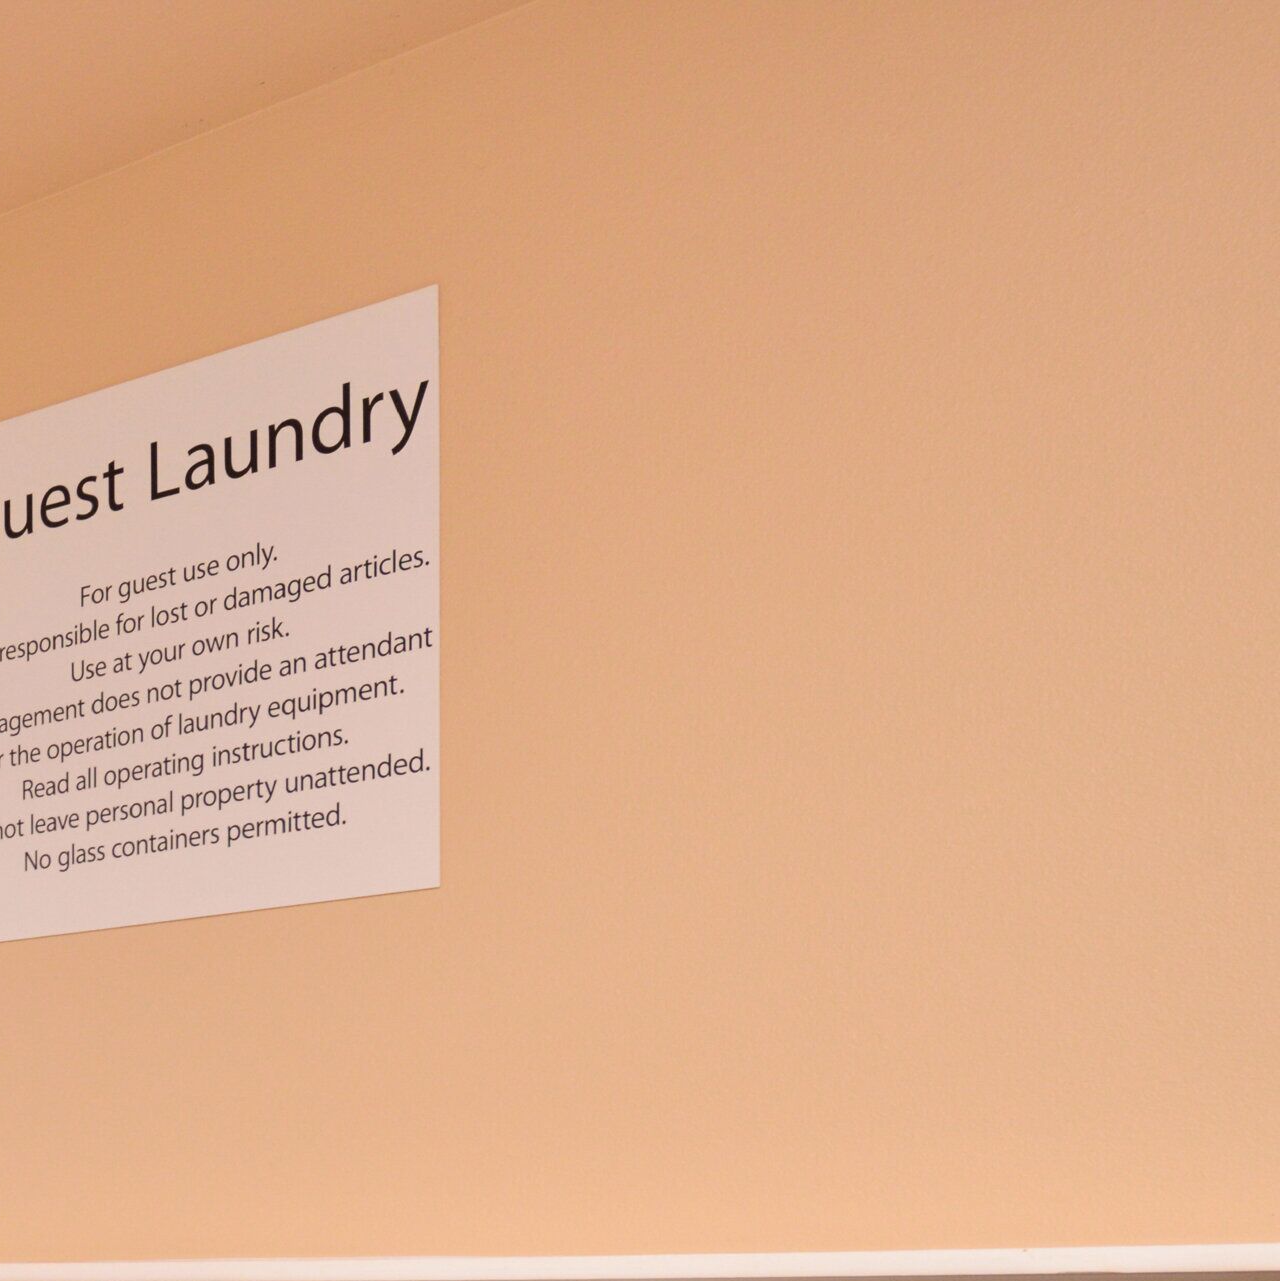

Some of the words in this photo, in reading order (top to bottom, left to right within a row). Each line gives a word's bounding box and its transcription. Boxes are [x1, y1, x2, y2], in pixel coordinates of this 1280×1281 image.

[149, 378, 431, 503] Laundry
[79, 583, 114, 609] For
[117, 566, 178, 605] guest
[182, 558, 221, 584] use
[225, 540, 279, 573] only.
[114, 611, 146, 637] for
[150, 601, 189, 629] lost
[193, 596, 219, 619] or
[222, 563, 333, 612] damaged
[338, 547, 431, 586] articles.
[70, 658, 108, 684] Use
[112, 651, 134, 675] at
[137, 642, 187, 676] your
[190, 630, 240, 658] own
[246, 615, 291, 646] risk.
[89, 689, 141, 716] does
[146, 678, 184, 705] not
[188, 657, 273, 703] provide
[277, 655, 308, 679] an
[313, 626, 434, 671] attendant
[7, 743, 42, 768] the
[45, 726, 145, 765] operation
[149, 713, 175, 742] of
[177, 700, 262, 737] laundry
[266, 674, 406, 722] equipment.
[21, 770, 71, 802] Read
[74, 765, 98, 792] all
[102, 752, 205, 791] operating
[211, 727, 350, 769] instructions.
[29, 811, 81, 836] leave
[85, 789, 174, 833] personal
[180, 778, 279, 818] property
[284, 746, 432, 795] unattended.
[23, 848, 53, 873] No
[56, 842, 107, 874] glass
[110, 826, 221, 860] containers
[226, 800, 348, 849] permitted.
